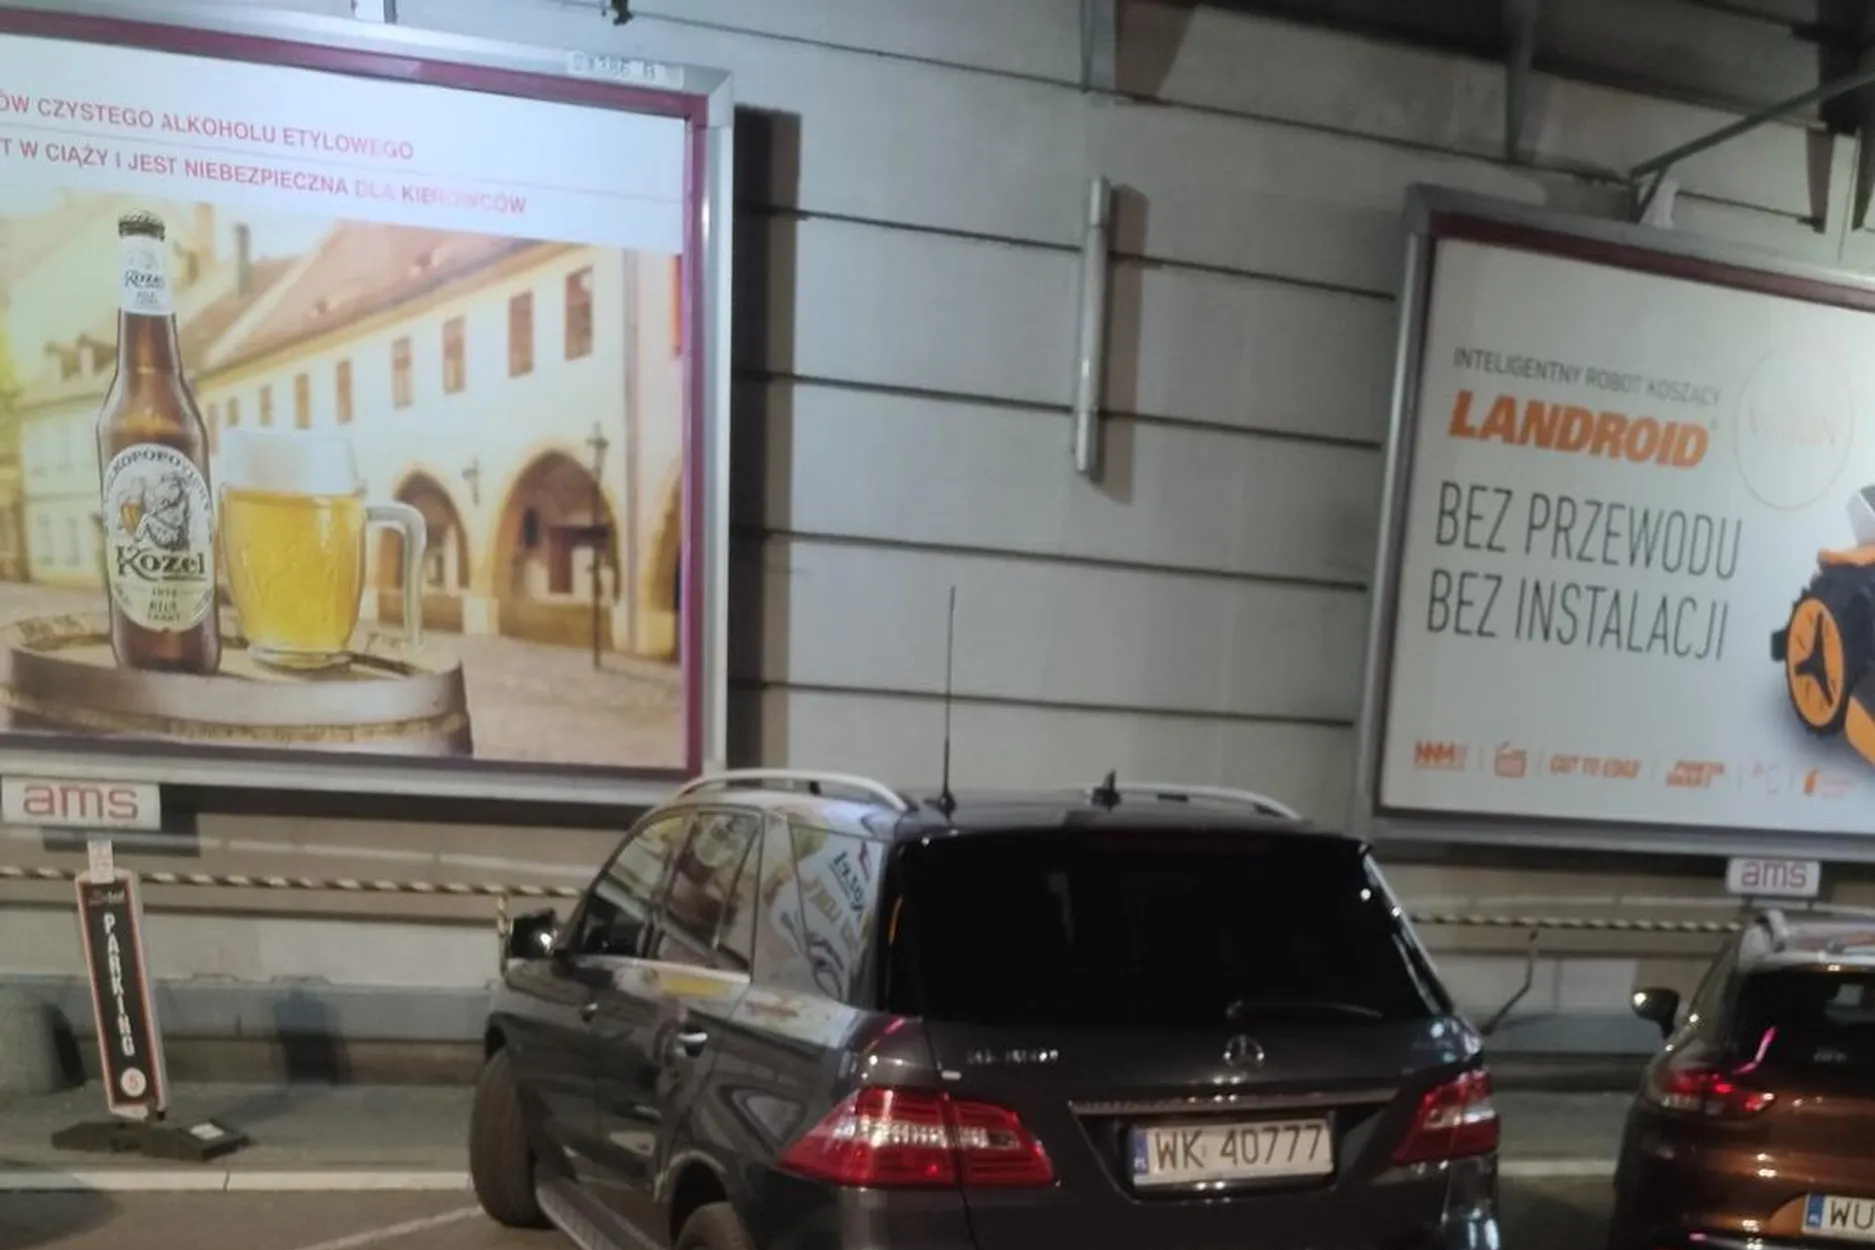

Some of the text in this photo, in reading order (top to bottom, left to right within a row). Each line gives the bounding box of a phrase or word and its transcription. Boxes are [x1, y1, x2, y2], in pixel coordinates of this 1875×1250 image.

[37, 97, 154, 128] CZYSTEGO
[161, 112, 276, 144] ALKOHOLU
[283, 127, 414, 160] ETYLOWEGO
[19, 138, 39, 160] W
[45, 142, 109, 168] CIĄŻY
[115, 151, 122, 168] I
[127, 152, 178, 175] JEST
[185, 159, 349, 196] NIEBEZPIECZNA
[355, 179, 397, 200] DLA
[1453, 347, 1584, 384] INTELIGENTNY
[1585, 366, 1644, 393] ROBOT
[1447, 388, 1709, 469] LANDROID
[1435, 480, 1742, 580] BEZ PRZEWODU
[115, 545, 207, 580] Kozel
[1427, 568, 1729, 661] BEZ INSTALACJI
[23, 785, 139, 819] ams
[1740, 860, 1807, 889] ams
[103, 911, 136, 1057] PARKING
[1155, 1124, 1323, 1171] WK 40777
[1830, 1200, 1875, 1230] WU
